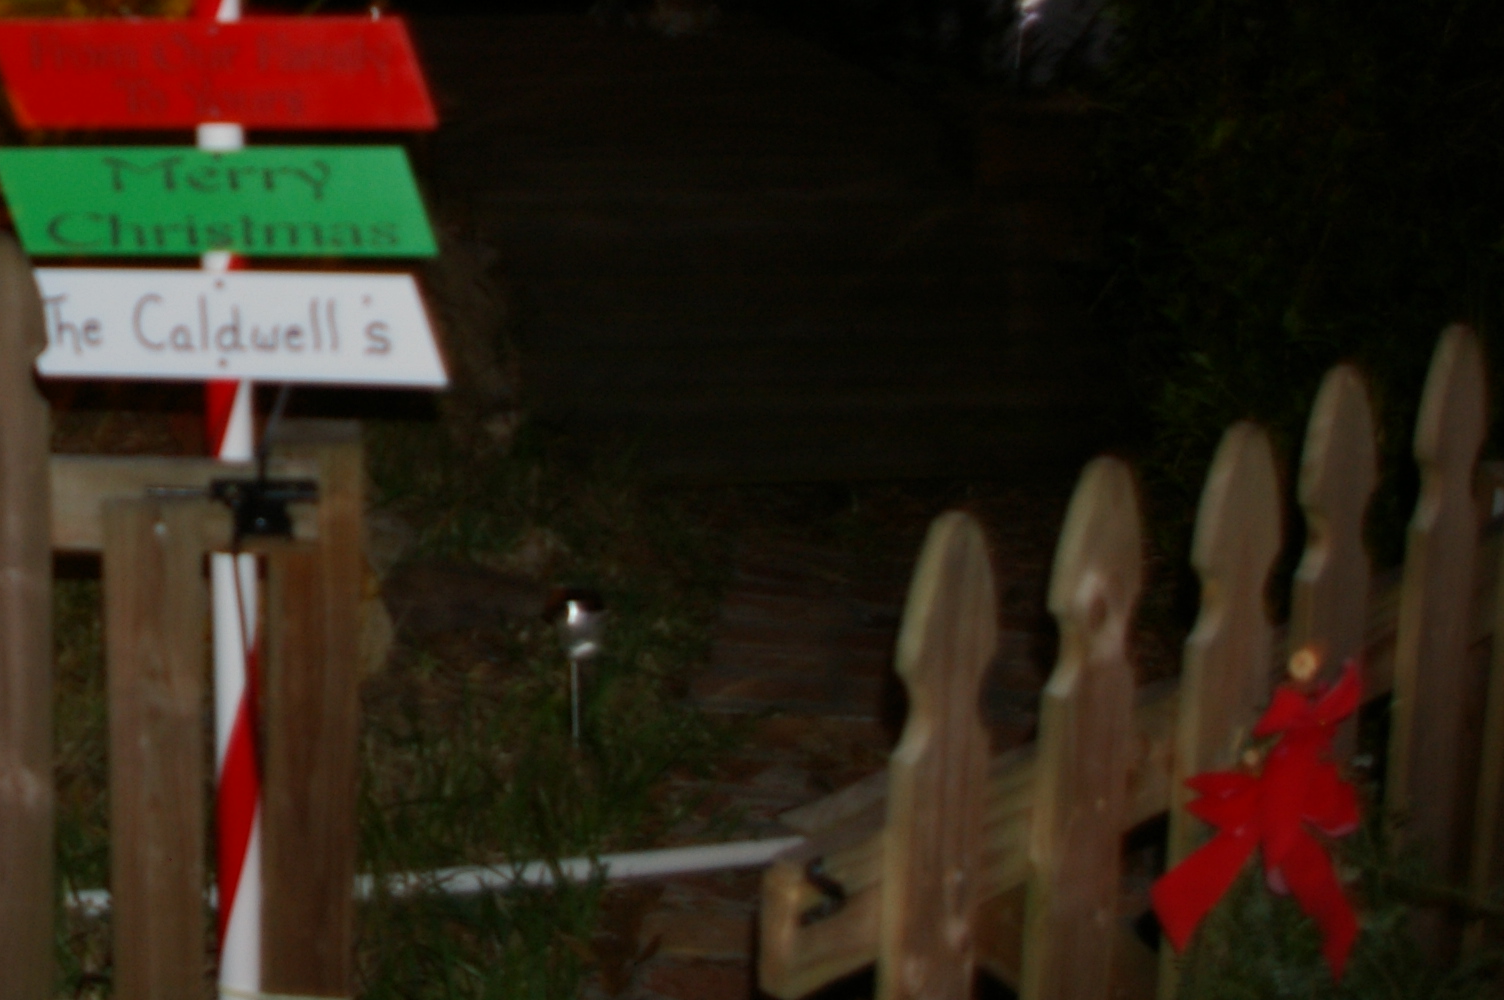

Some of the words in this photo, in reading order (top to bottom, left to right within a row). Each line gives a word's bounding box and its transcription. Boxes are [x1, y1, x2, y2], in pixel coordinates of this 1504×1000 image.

[27, 32, 139, 71] From
[151, 32, 240, 72] Our
[112, 76, 169, 117] To
[102, 154, 332, 201] Merry
[46, 211, 402, 249] Christmas
[44, 293, 103, 356] The
